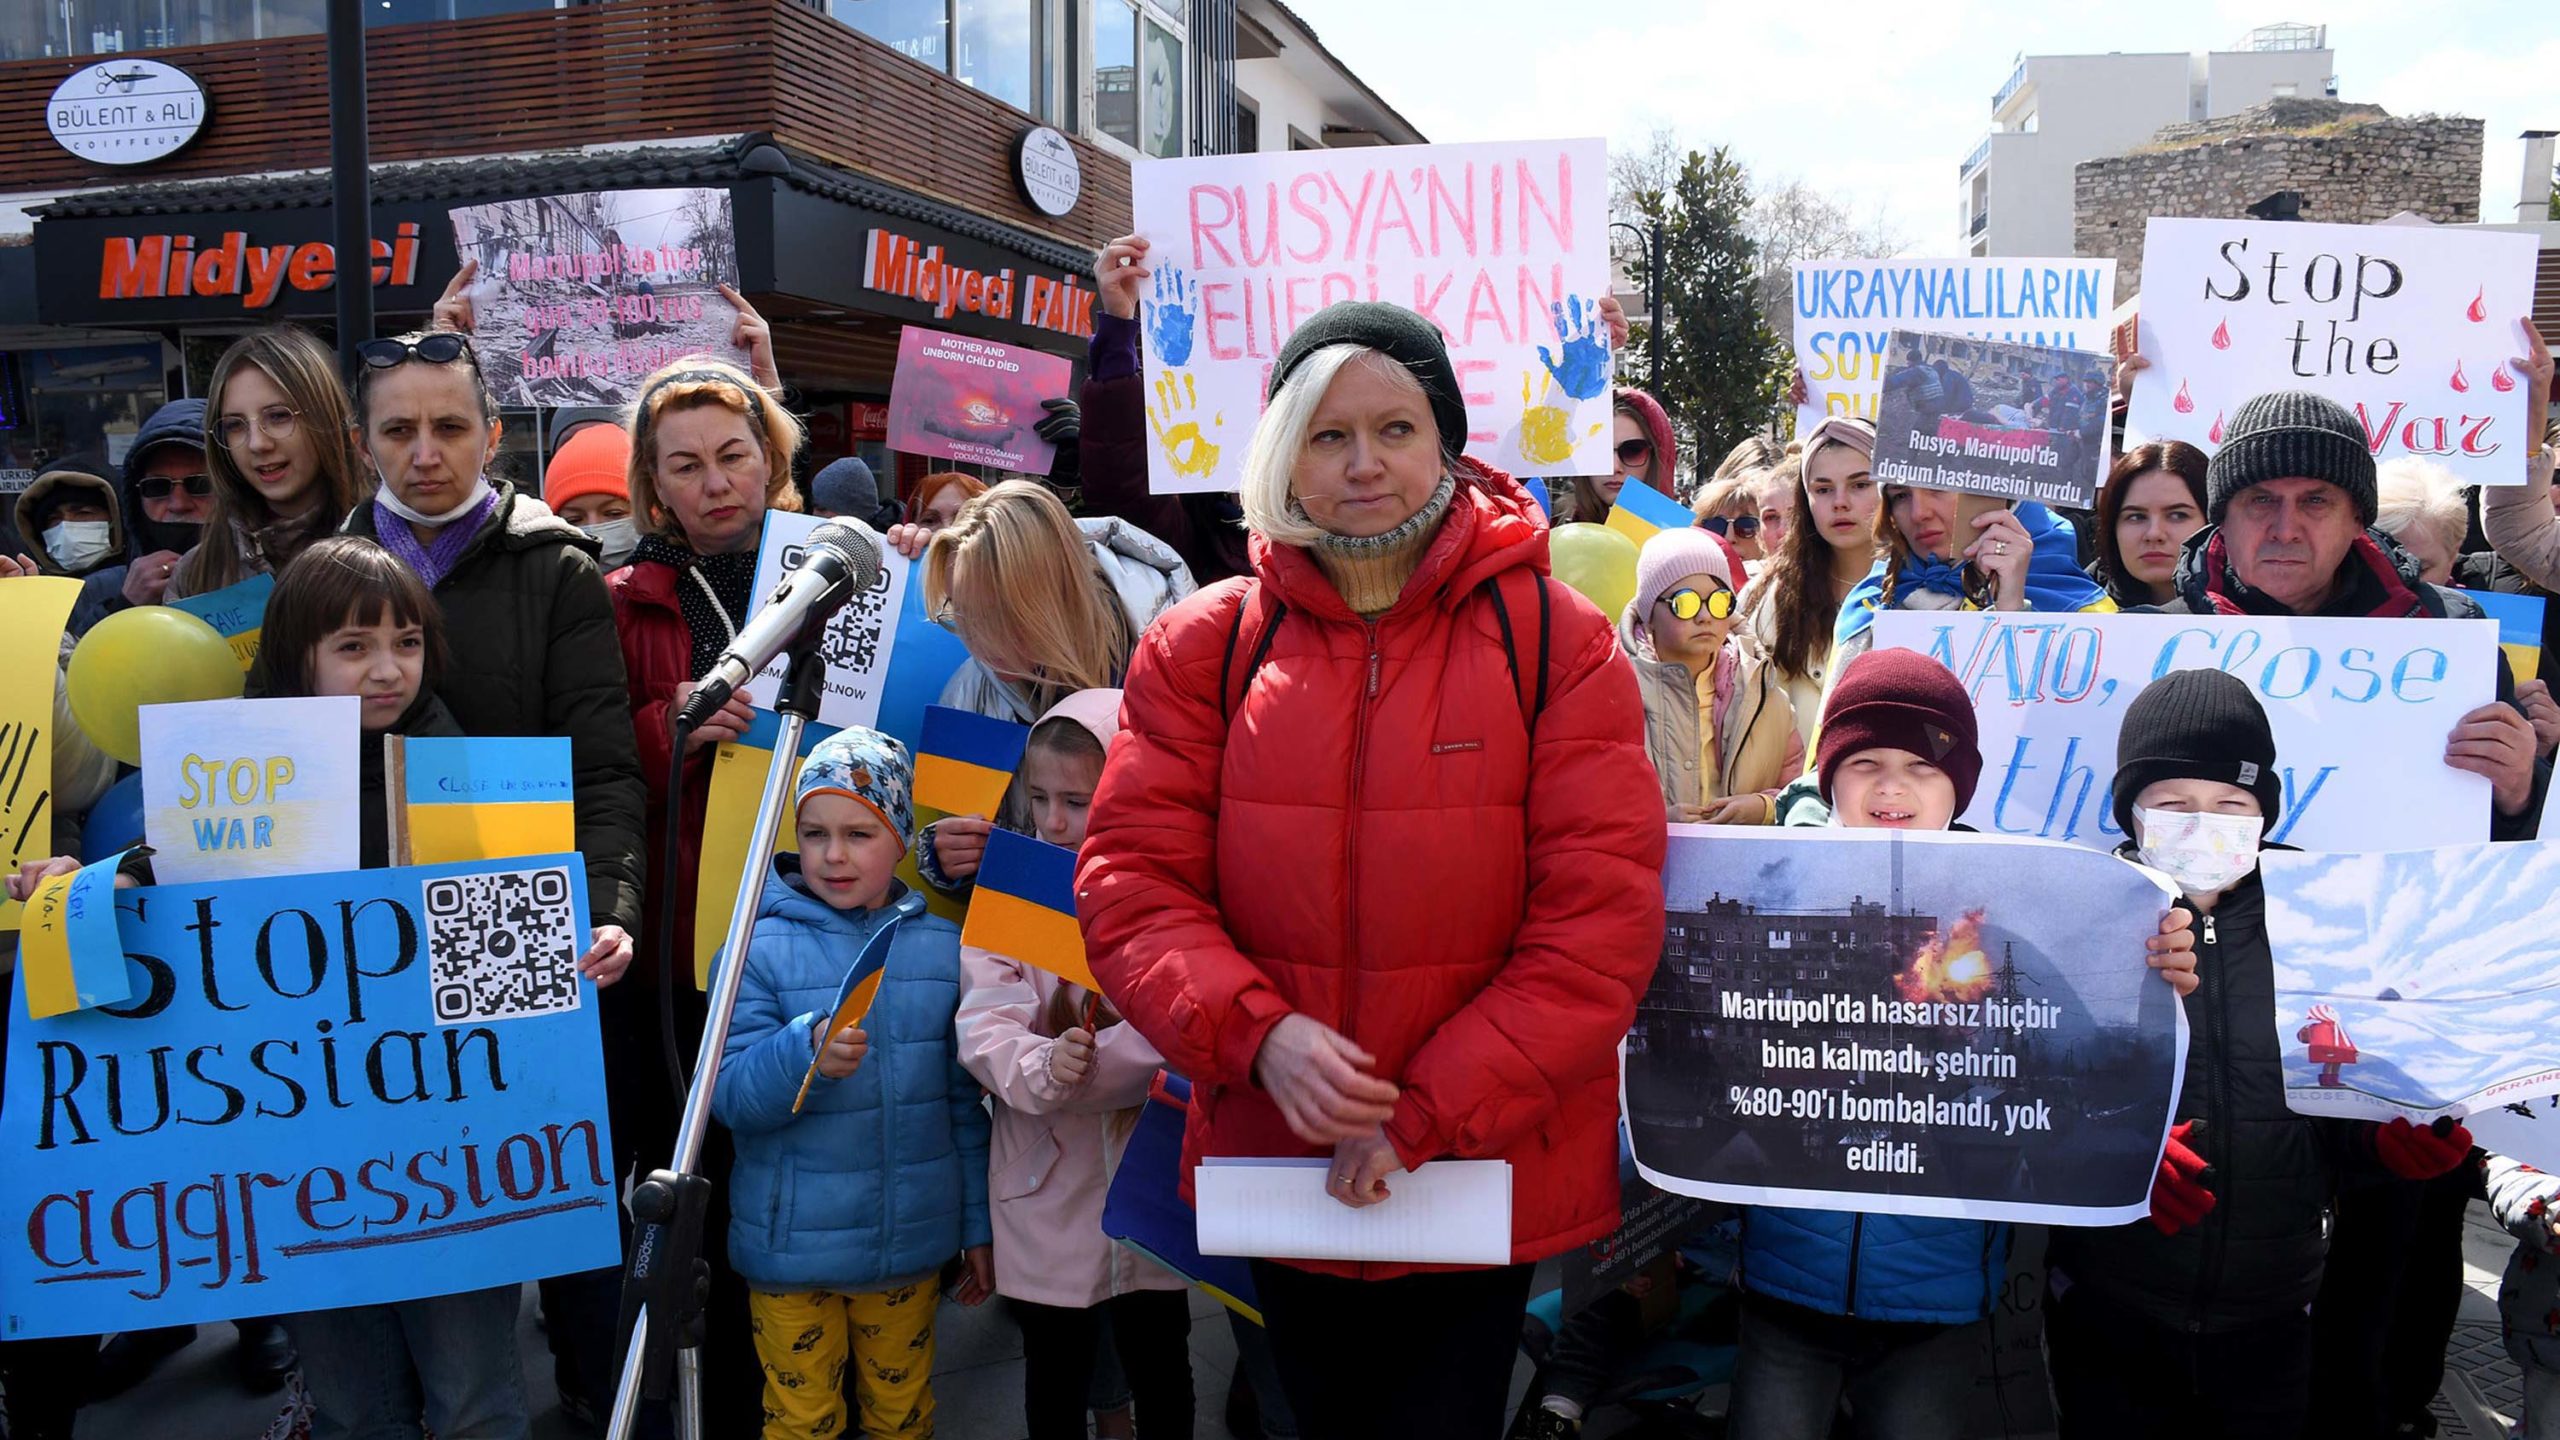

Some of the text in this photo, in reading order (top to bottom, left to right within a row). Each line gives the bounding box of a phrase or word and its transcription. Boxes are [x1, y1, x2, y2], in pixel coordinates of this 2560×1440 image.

[57, 97, 195, 128] BÜLENT & ALİ
[74, 136, 180, 150] COIFFEUR
[1189, 151, 1573, 270] RUSYA'NIN
[509, 241, 702, 283] Mariupol'da her
[863, 228, 1015, 319] Midyeci
[2204, 237, 2404, 323] Stop
[662, 295, 703, 321] rus
[1414, 262, 1563, 348] KAN
[1797, 267, 2101, 319] UKRAYNALILARIN
[922, 346, 964, 363] UNBORN
[940, 337, 1005, 358] MOTHER AND
[2285, 319, 2400, 378] the
[1909, 429, 2059, 468] Rusya, Mariupol'da
[1877, 458, 2081, 503] doğum hastanesini vurdu
[1927, 616, 2118, 708] NATO,
[178, 753, 295, 809] STOP
[193, 815, 273, 850] WAR
[68, 871, 96, 920] Stop
[95, 896, 418, 1026] Stop
[1721, 991, 2062, 1035] Mariupol'da hasarsız hiçbir
[1762, 1041, 2017, 1082] bina kalmadı, şehrin
[1730, 1085, 2051, 1135] %80-90'ı bombalandı, yok
[2287, 1089, 2345, 1101] CLOSE
[1846, 1141, 1925, 1174] edildi.
[27, 1119, 611, 1299] aggression
